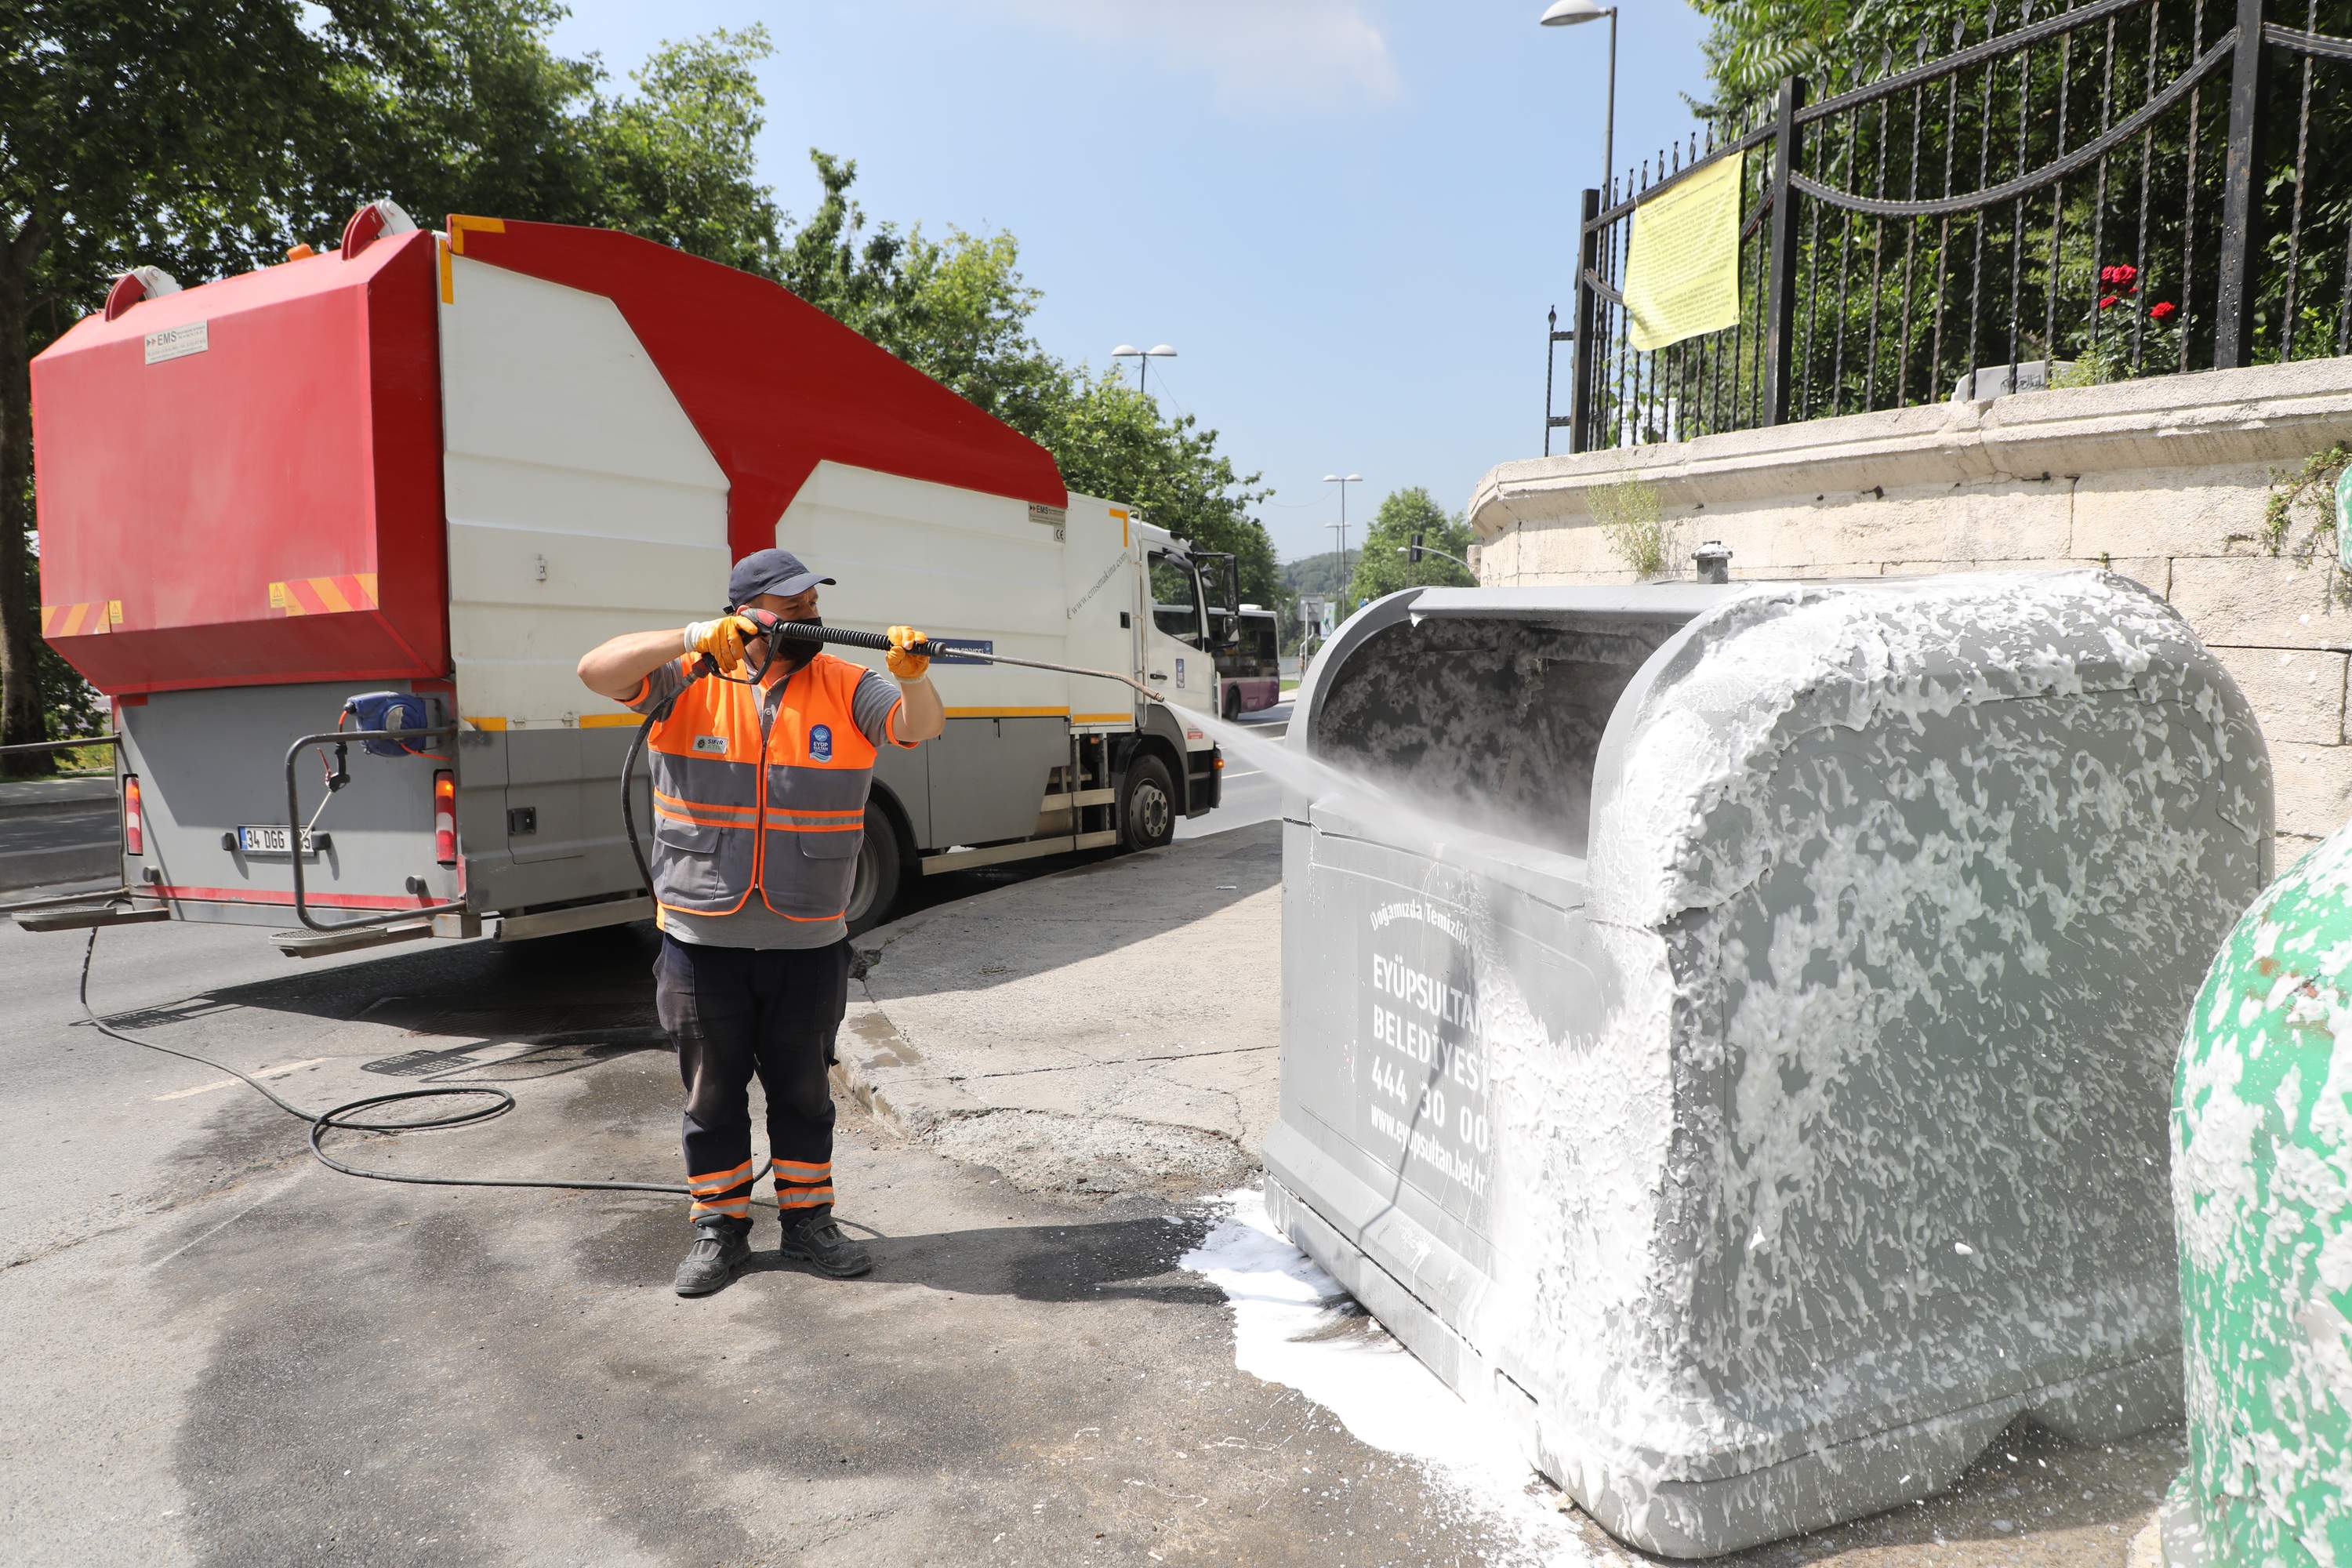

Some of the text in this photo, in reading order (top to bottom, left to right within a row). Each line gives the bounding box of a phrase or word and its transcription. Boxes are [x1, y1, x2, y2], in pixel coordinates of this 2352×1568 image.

[158, 331, 177, 346] EMS
[1036, 504, 1049, 514] EMS
[246, 830, 260, 848] 34
[264, 829, 285, 849] DGG
[1370, 898, 1470, 949] Doğamızda Temizlik
[1372, 1055, 1489, 1153] 444 30 00
